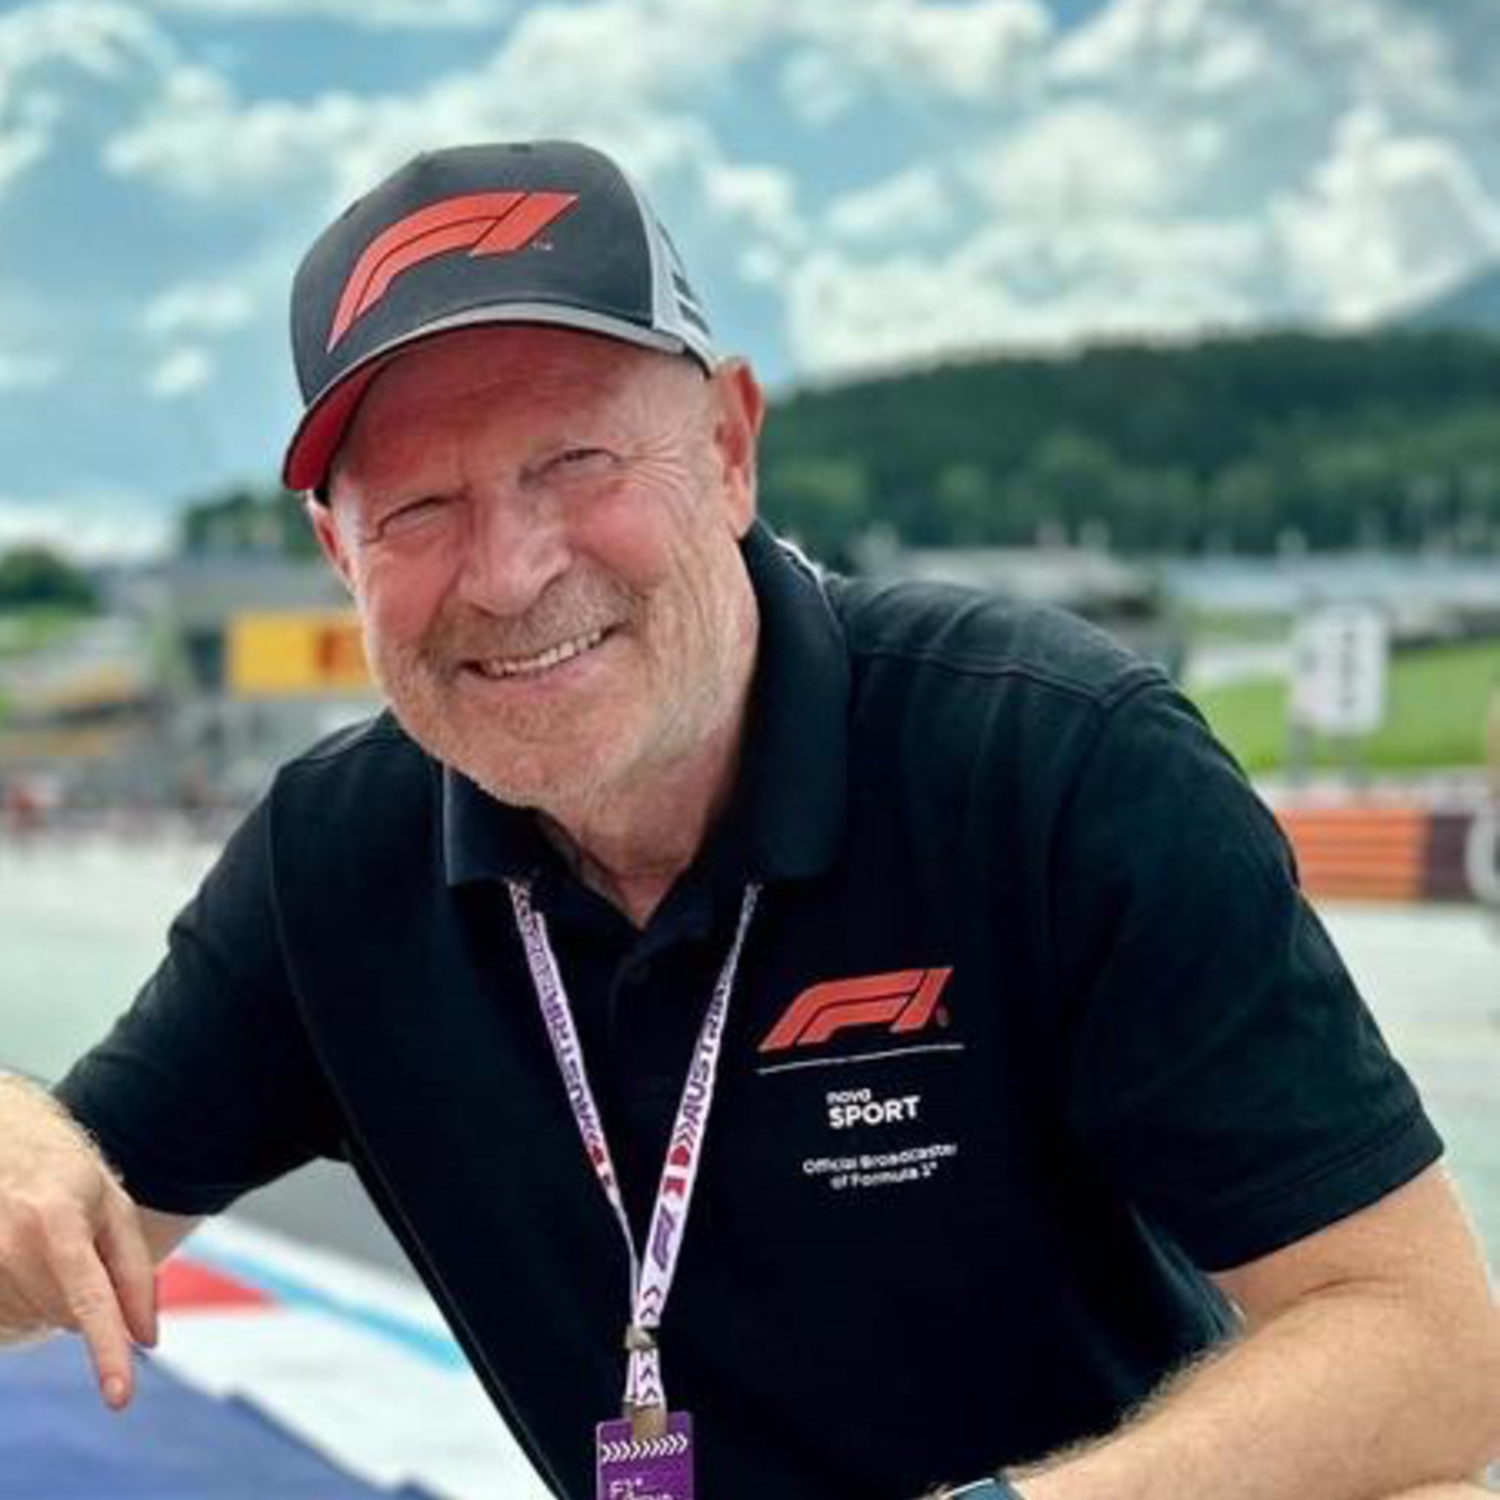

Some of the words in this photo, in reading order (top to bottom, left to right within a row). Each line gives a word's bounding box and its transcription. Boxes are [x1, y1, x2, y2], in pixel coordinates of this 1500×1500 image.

[326, 190, 580, 353] F1
[758, 966, 953, 1052] F1
[829, 1095, 921, 1128] SPORT
[803, 1157, 857, 1175] Official
[860, 1143, 957, 1168] Broadcaster
[851, 1167, 918, 1187] Formula
